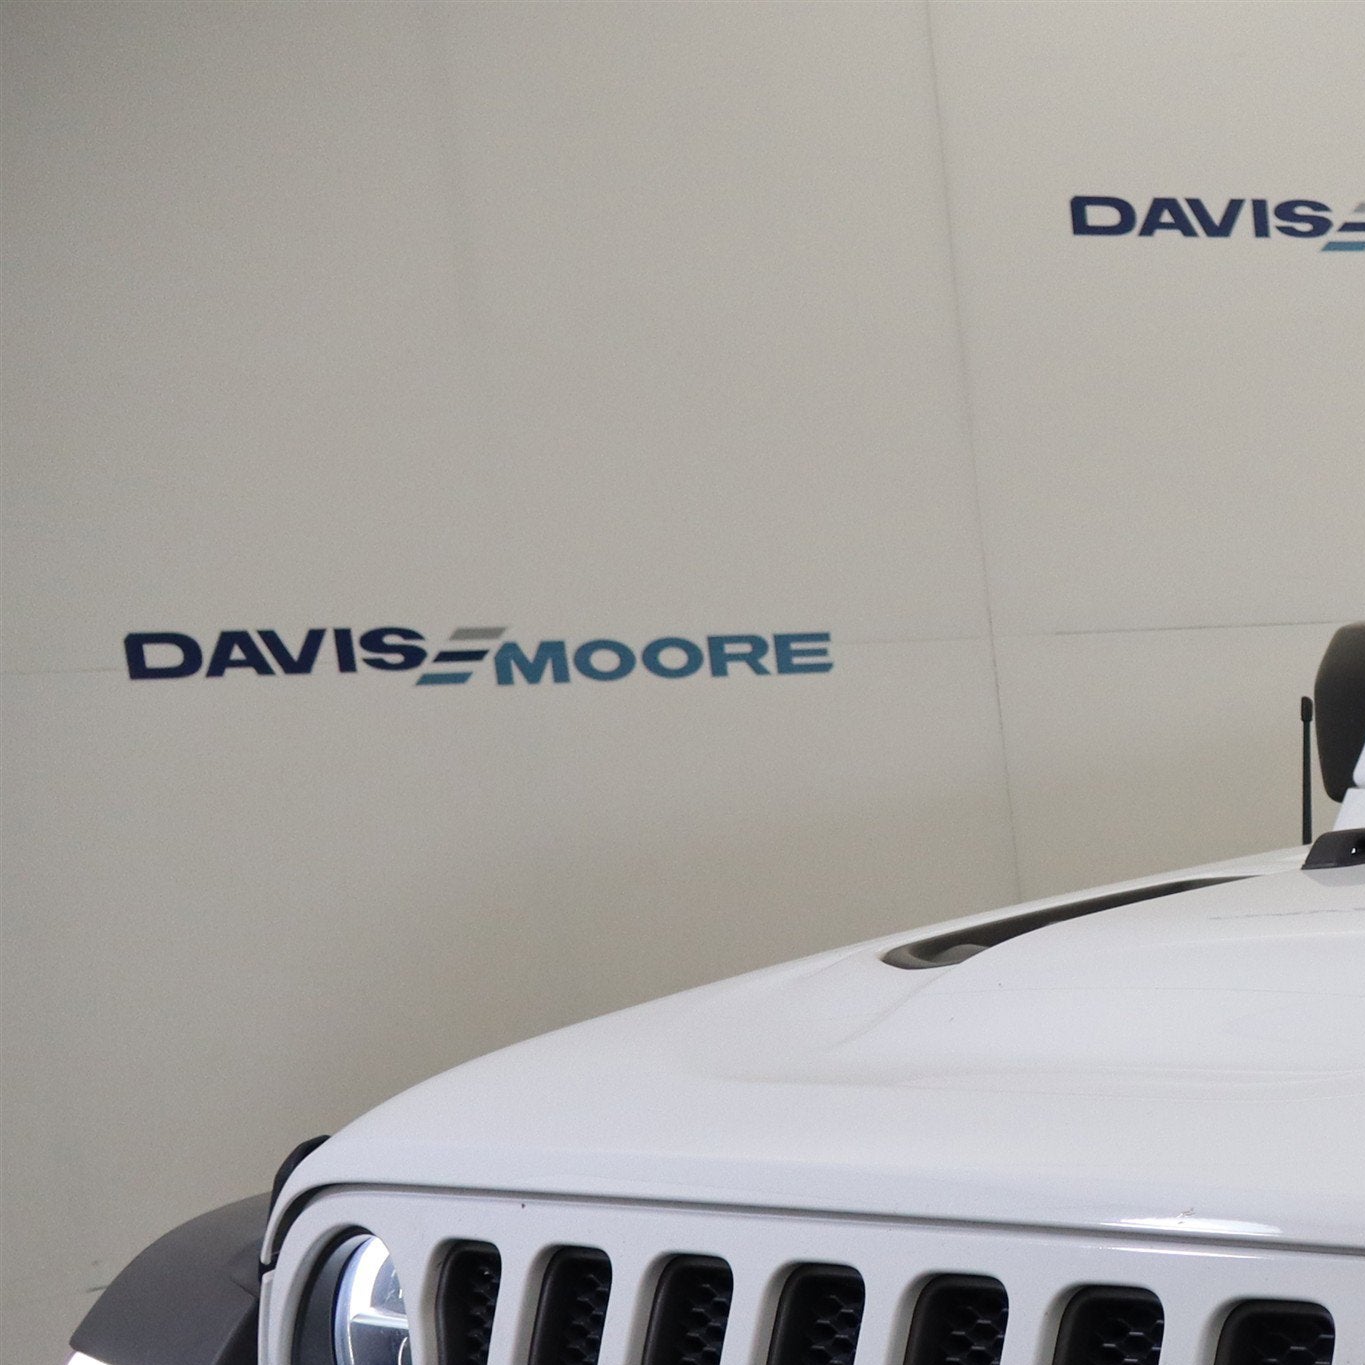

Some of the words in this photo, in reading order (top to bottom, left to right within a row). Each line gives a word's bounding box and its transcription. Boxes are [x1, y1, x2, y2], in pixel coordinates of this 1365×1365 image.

[1071, 195, 1335, 239] DAVIS
[122, 626, 429, 681] DAVIS
[494, 632, 835, 686] MOORE
